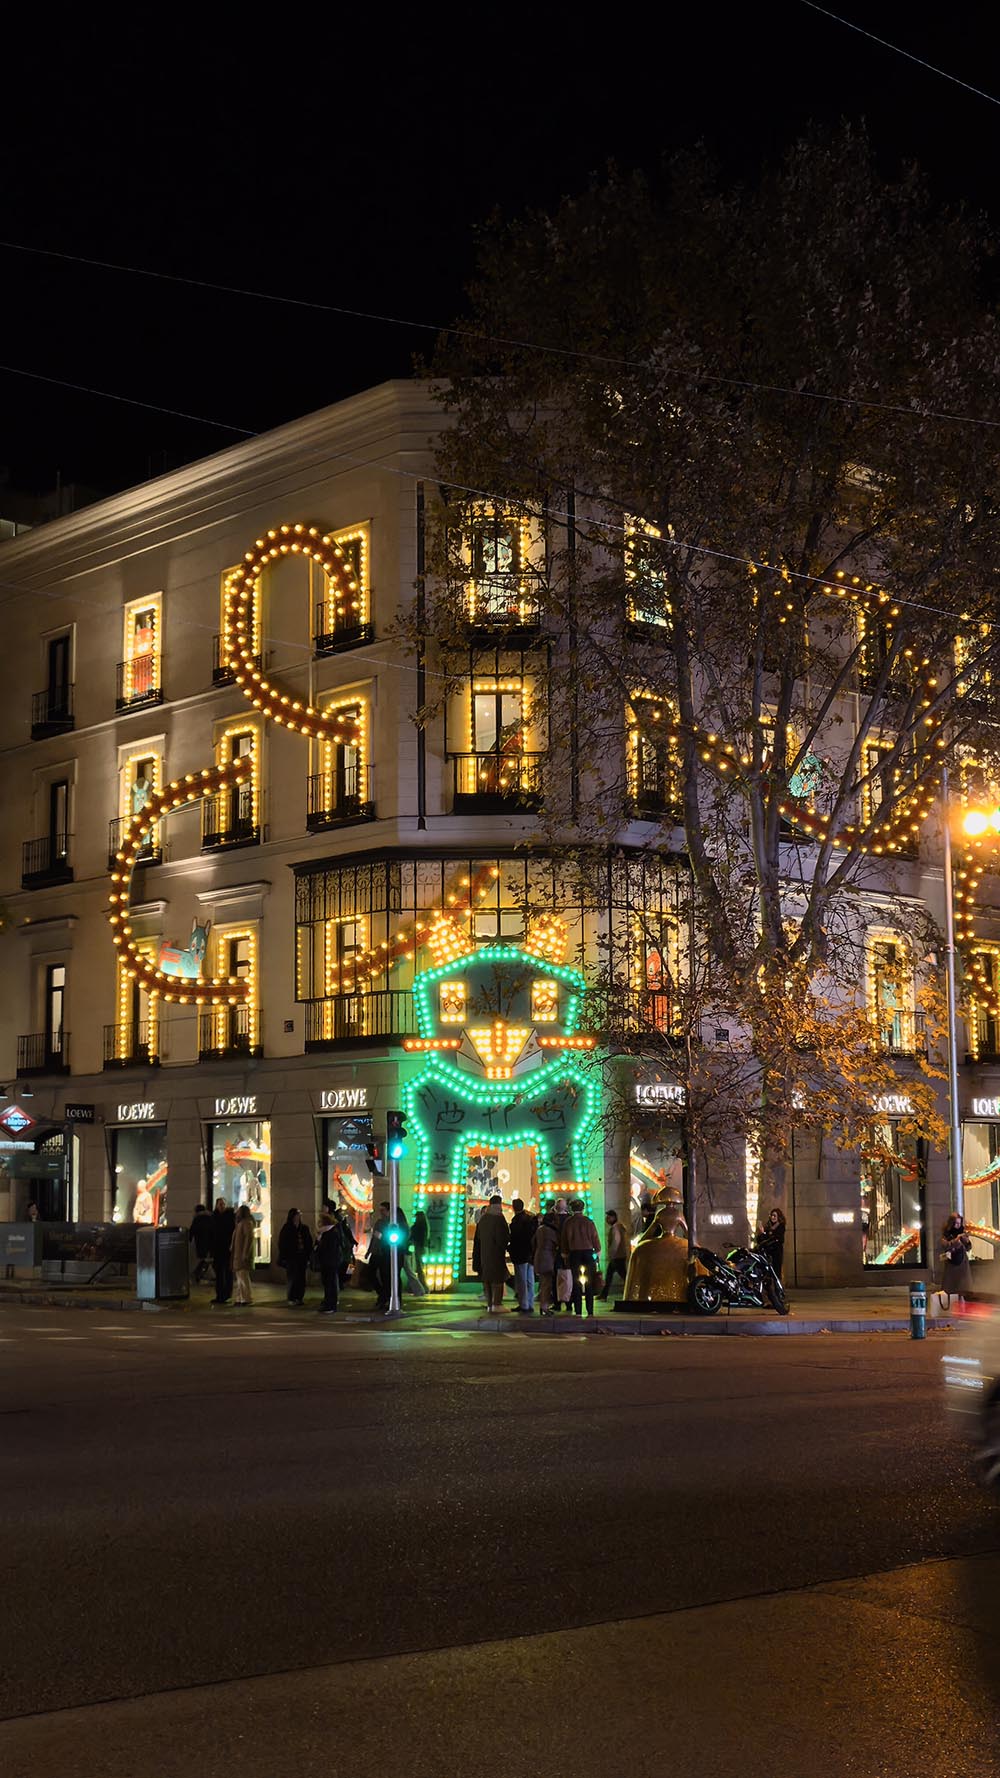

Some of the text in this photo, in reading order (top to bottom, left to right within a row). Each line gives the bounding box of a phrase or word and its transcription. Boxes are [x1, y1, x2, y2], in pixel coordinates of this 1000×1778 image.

[215, 1096, 257, 1116] LOEWE
[320, 1088, 368, 1109] LOEWE
[66, 1107, 94, 1119] LOEWE
[117, 1102, 155, 1121] LOEWE
